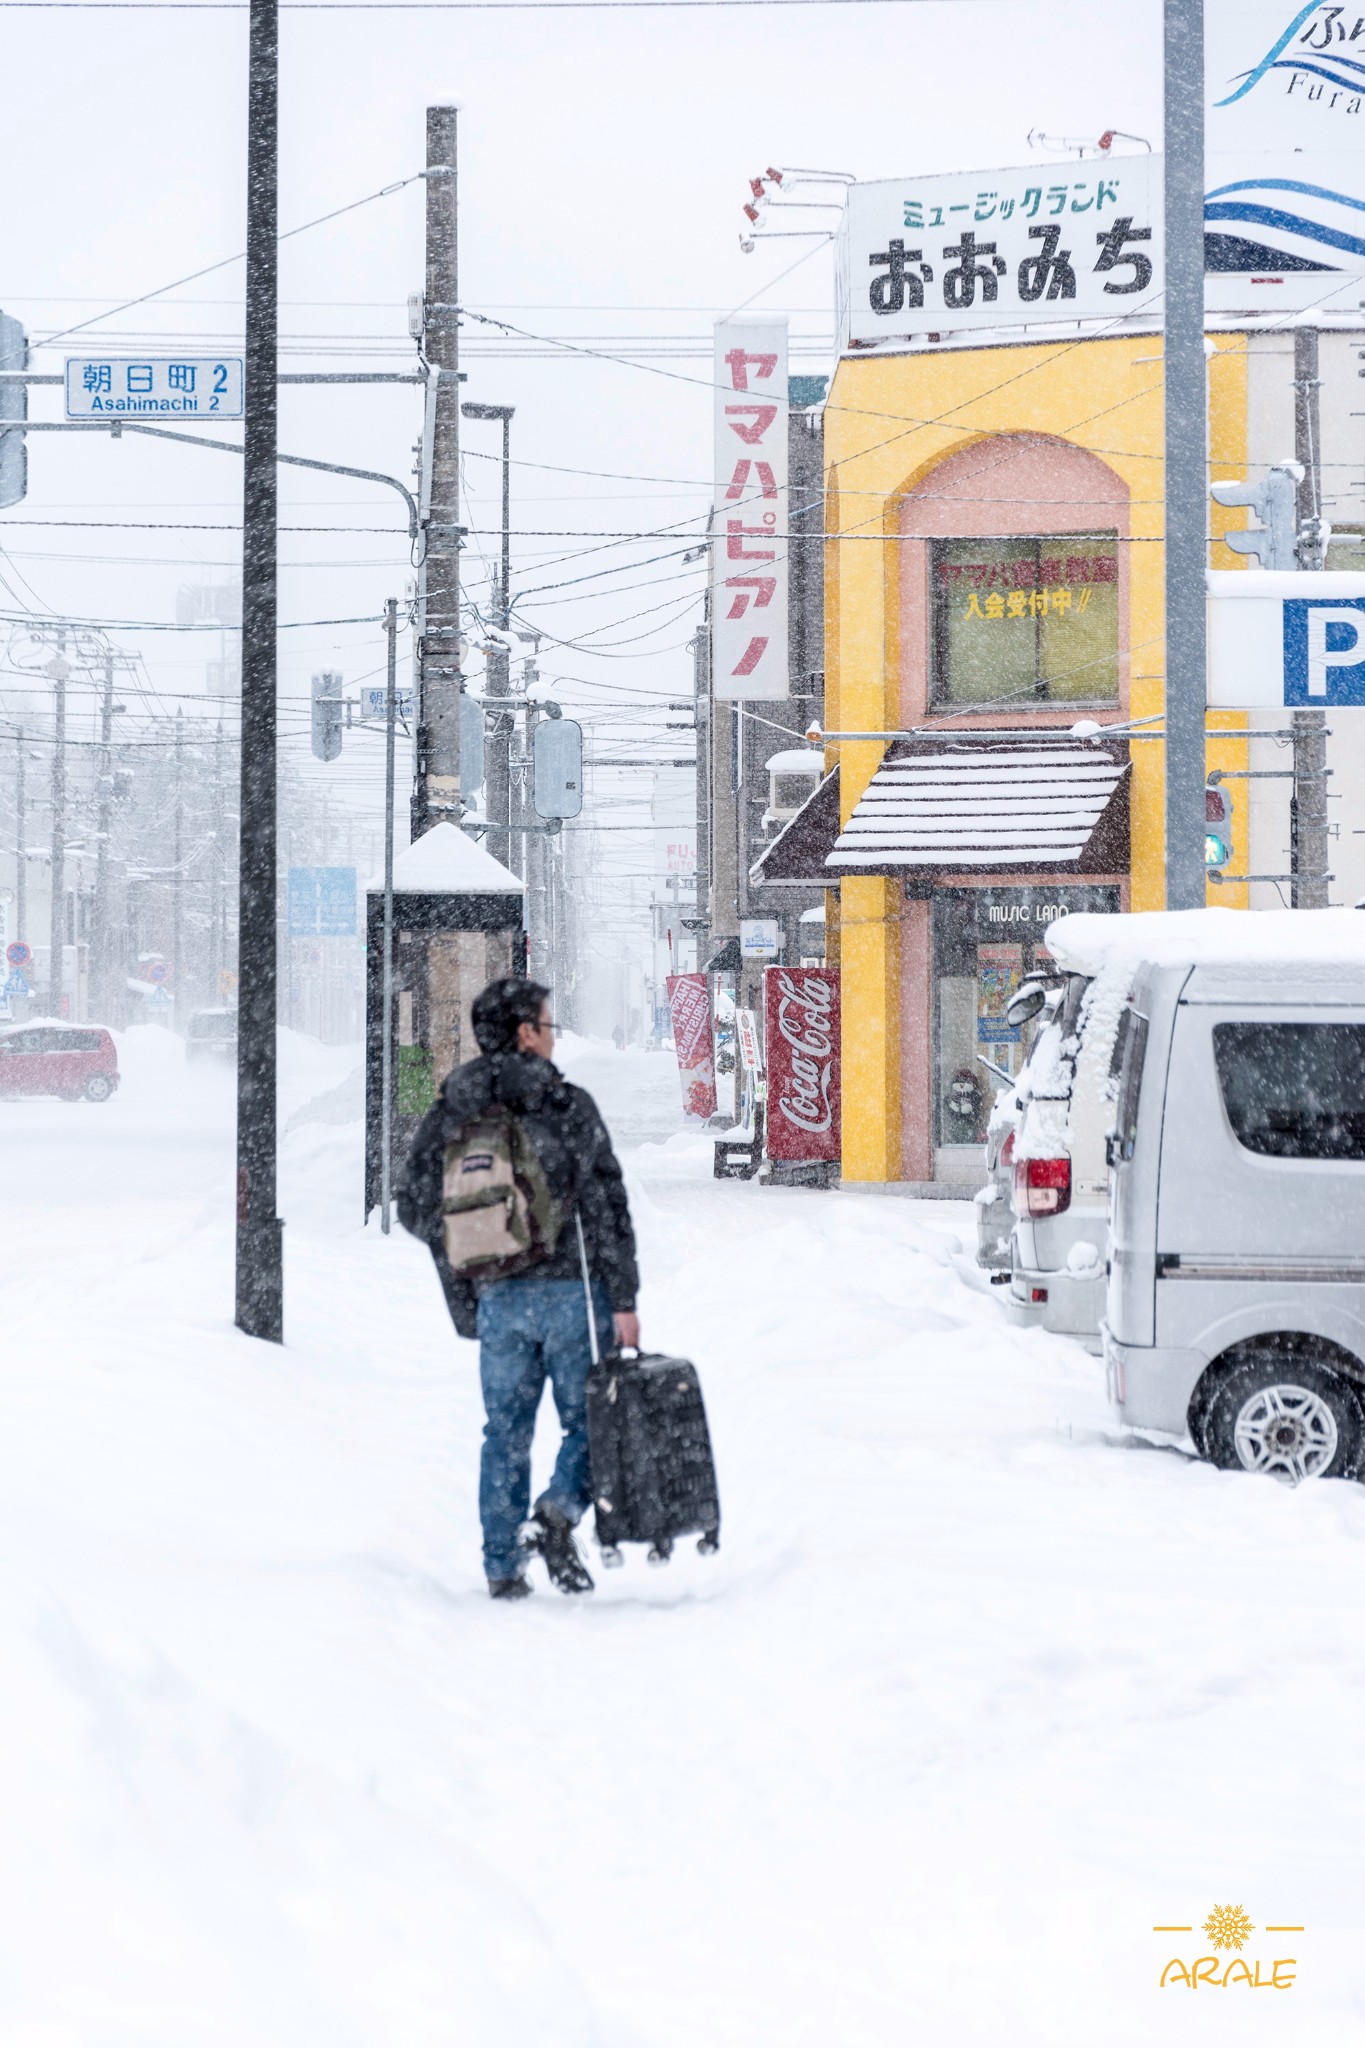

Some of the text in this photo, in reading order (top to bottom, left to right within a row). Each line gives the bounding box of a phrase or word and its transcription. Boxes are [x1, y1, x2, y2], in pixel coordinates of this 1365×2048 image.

[902, 179, 1121, 230] ミュージックランド
[868, 216, 1153, 316] おおみち
[91, 395, 220, 412] Asahimachi 2
[724, 348, 779, 677] ヤマハピアノ
[1307, 606, 1365, 696] P
[989, 905, 1030, 922] MUSIC
[779, 971, 832, 1134] Coca-Cola
